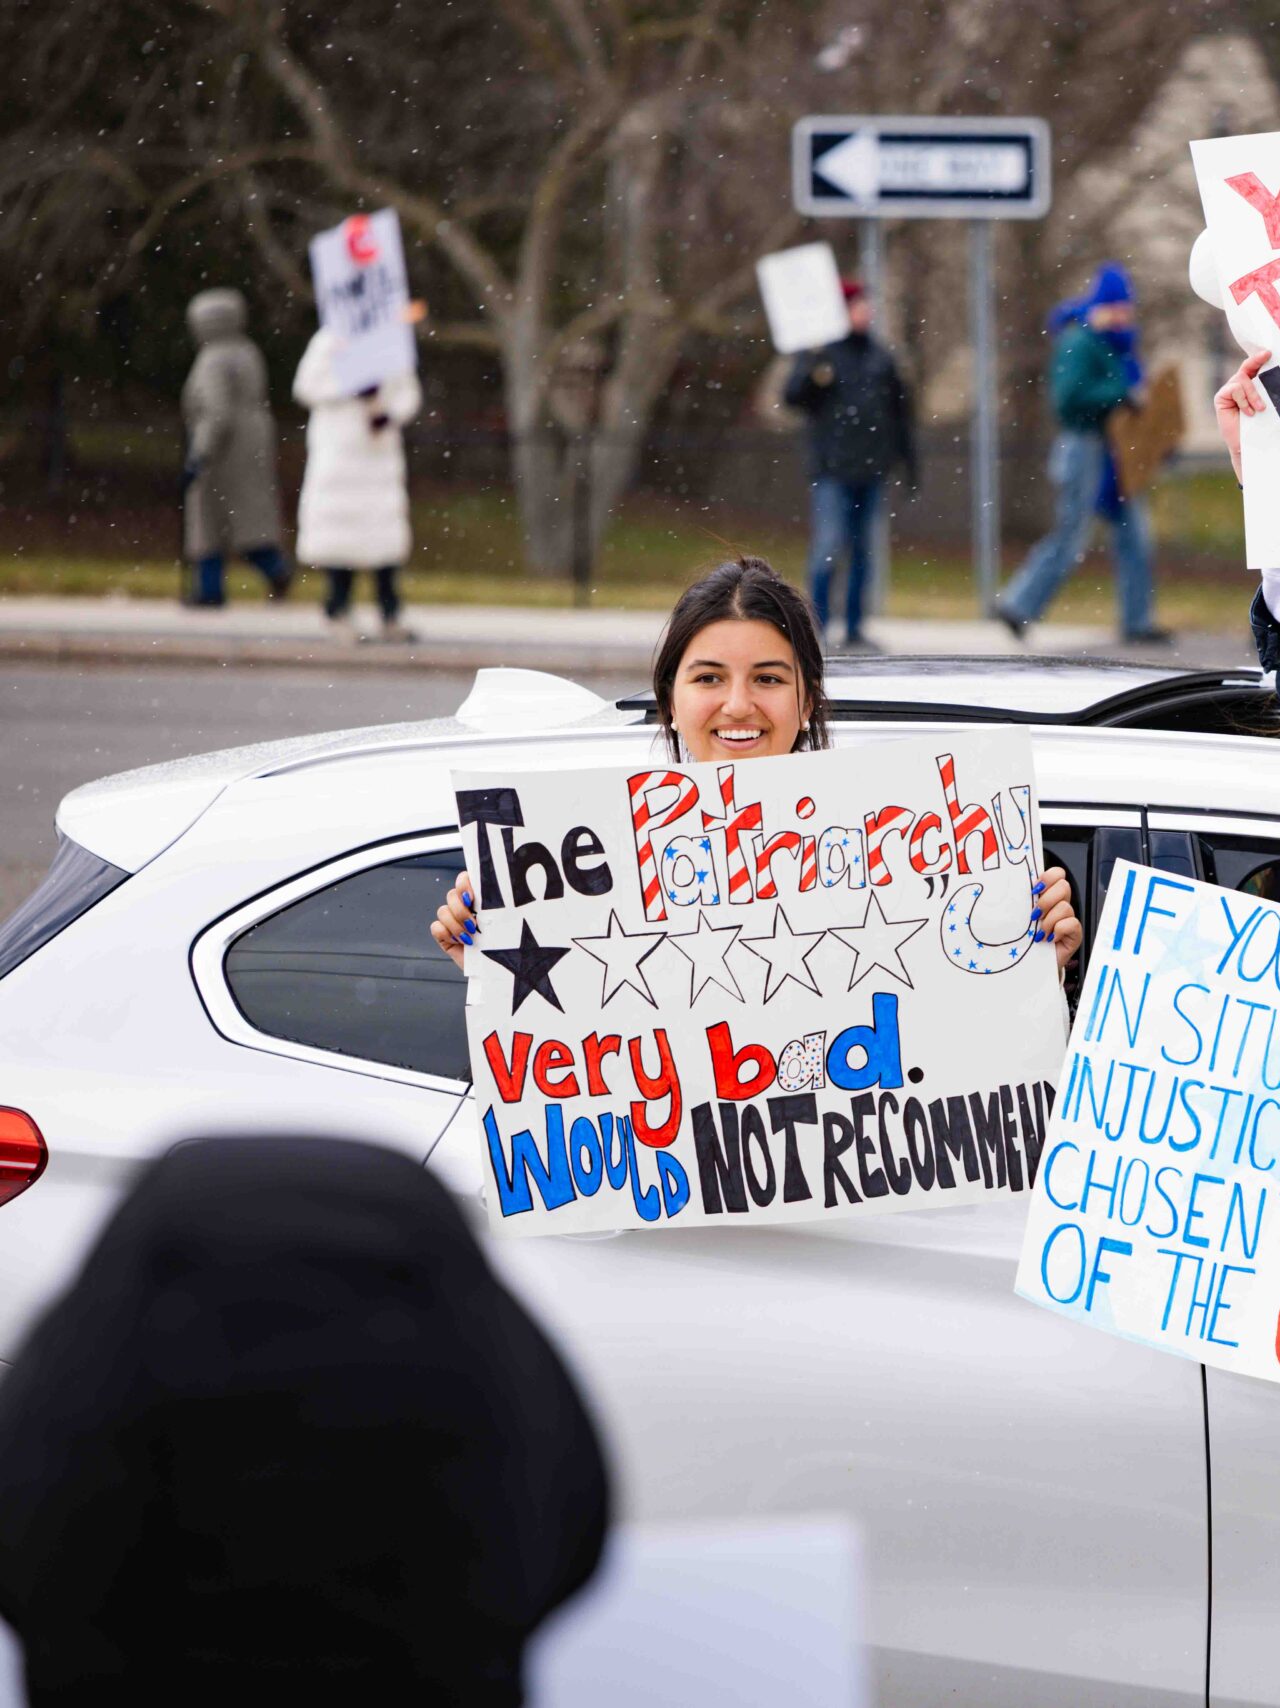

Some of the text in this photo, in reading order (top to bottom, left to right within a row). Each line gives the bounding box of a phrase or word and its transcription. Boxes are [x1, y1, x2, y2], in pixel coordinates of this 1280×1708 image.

[455, 753, 1041, 975] The Patriarchy
[1112, 869, 1196, 956] IF
[1084, 964, 1153, 1049] IN
[482, 992, 925, 1149] very bad.
[690, 1092, 819, 1213] NOT
[822, 1080, 1057, 1207] RECOMMEN
[1044, 1141, 1267, 1260] CHOSEN
[1040, 1222, 1133, 1312] OF
[1156, 1248, 1257, 1348] THE
